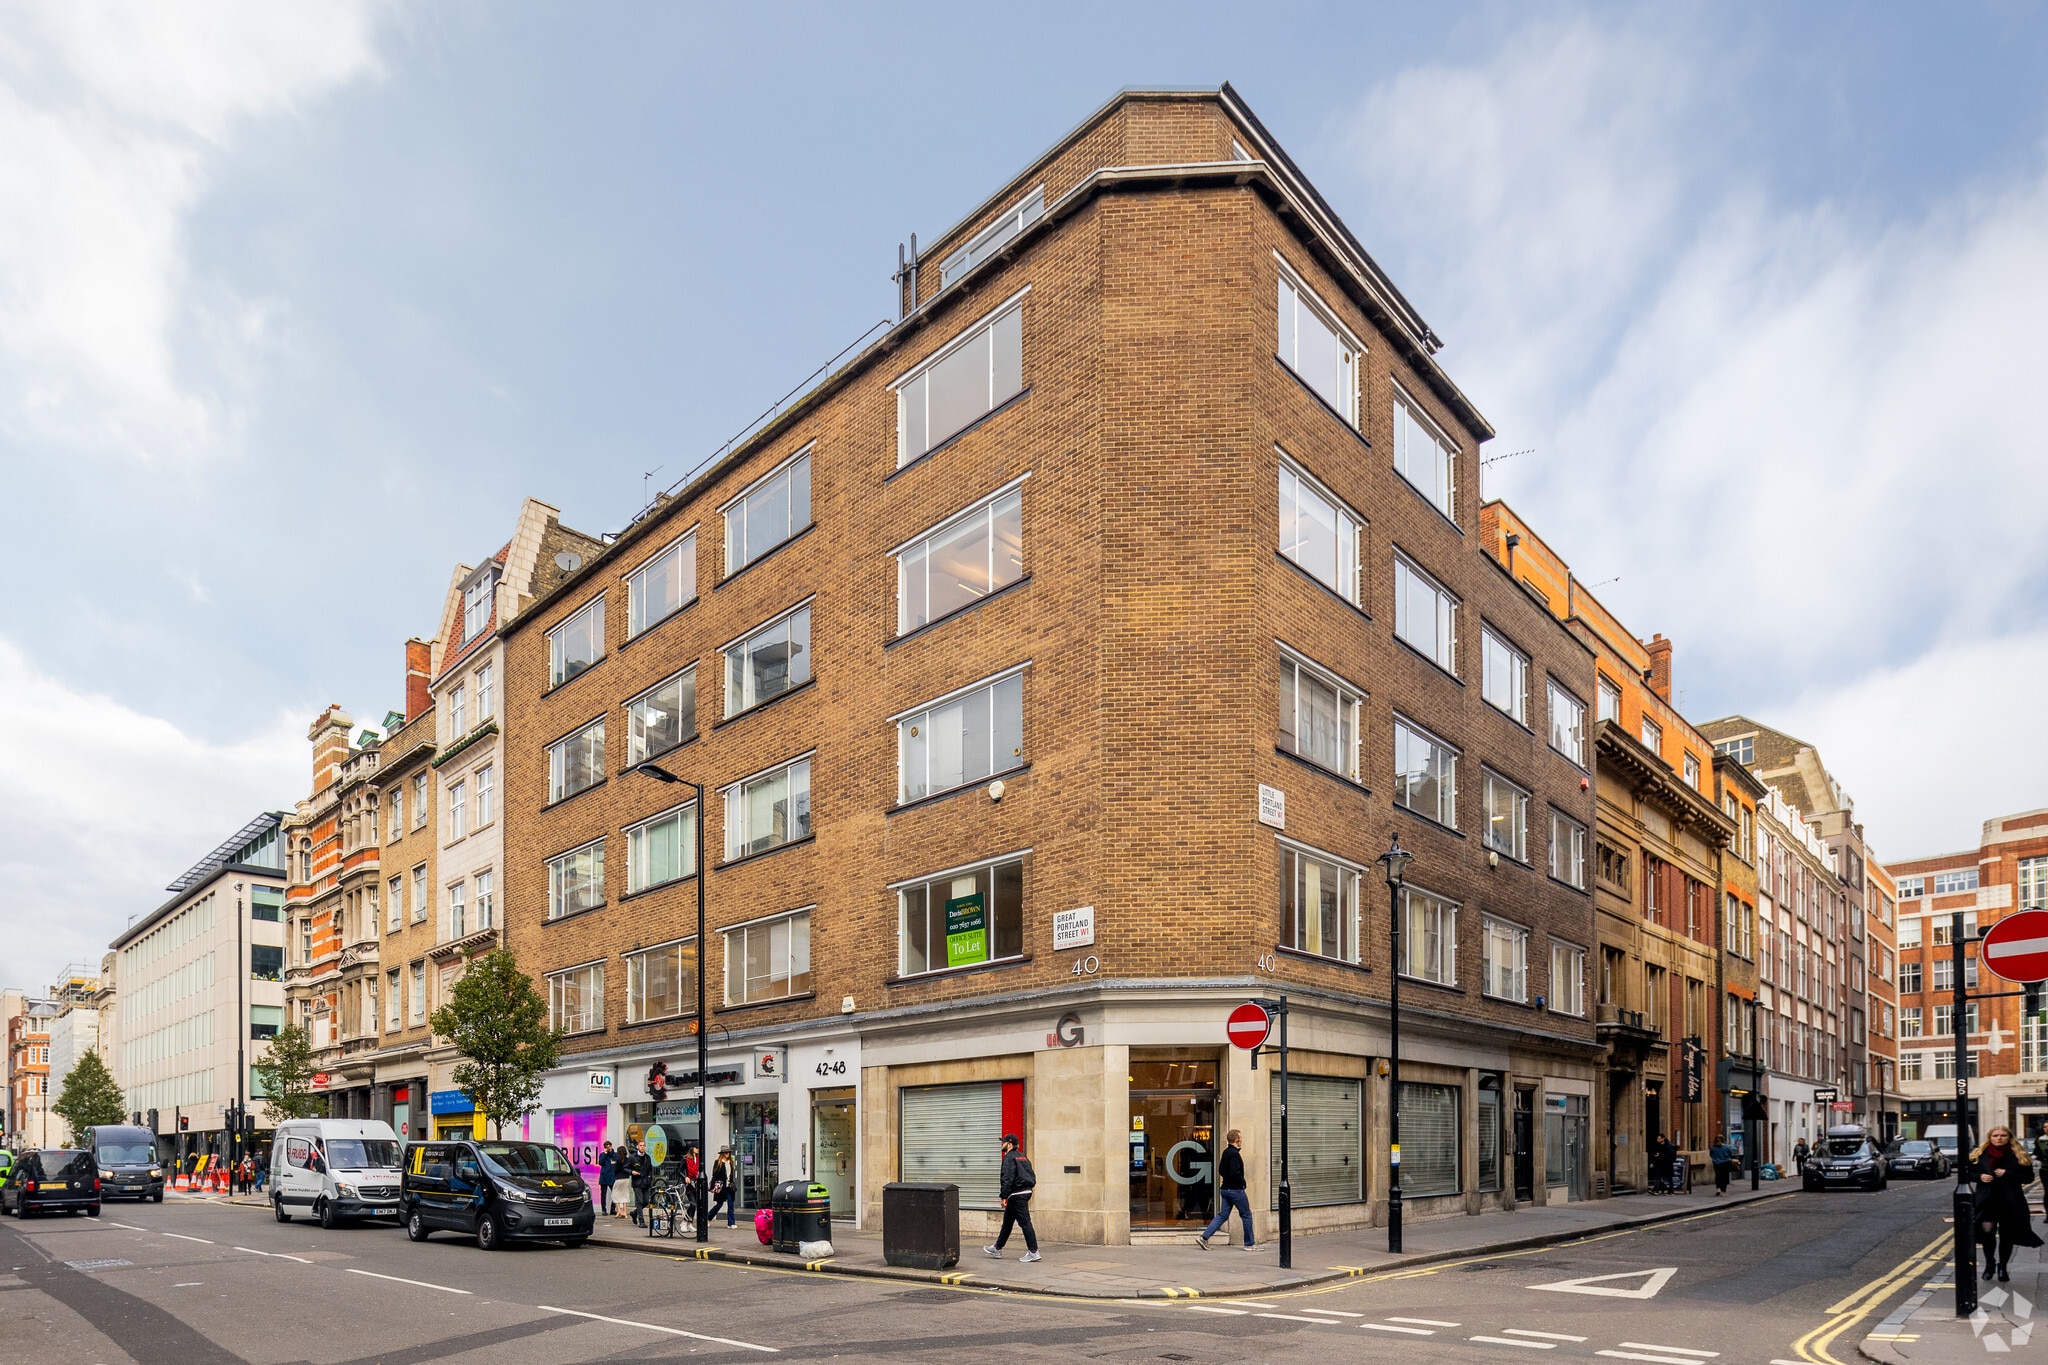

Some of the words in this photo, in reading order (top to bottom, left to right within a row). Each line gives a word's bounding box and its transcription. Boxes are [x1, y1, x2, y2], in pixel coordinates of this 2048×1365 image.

[1262, 787, 1275, 798] LITTLE
[1262, 797, 1283, 811] PORTLAND
[1262, 806, 1277, 817] STREET
[1057, 912, 1076, 923] GREAT
[1057, 919, 1089, 932] PORTLAND
[949, 935, 967, 943] OFFICE
[967, 930, 982, 940] SUITE
[1057, 929, 1079, 941] STREET
[1080, 927, 1089, 936] W1
[952, 943, 965, 955] To
[966, 940, 981, 953] Let
[1071, 955, 1099, 976] 40
[1257, 953, 1275, 972] 40
[815, 1060, 847, 1076] 42-48
[1957, 1079, 1967, 1088] S
[1165, 1140, 1212, 1185] G
